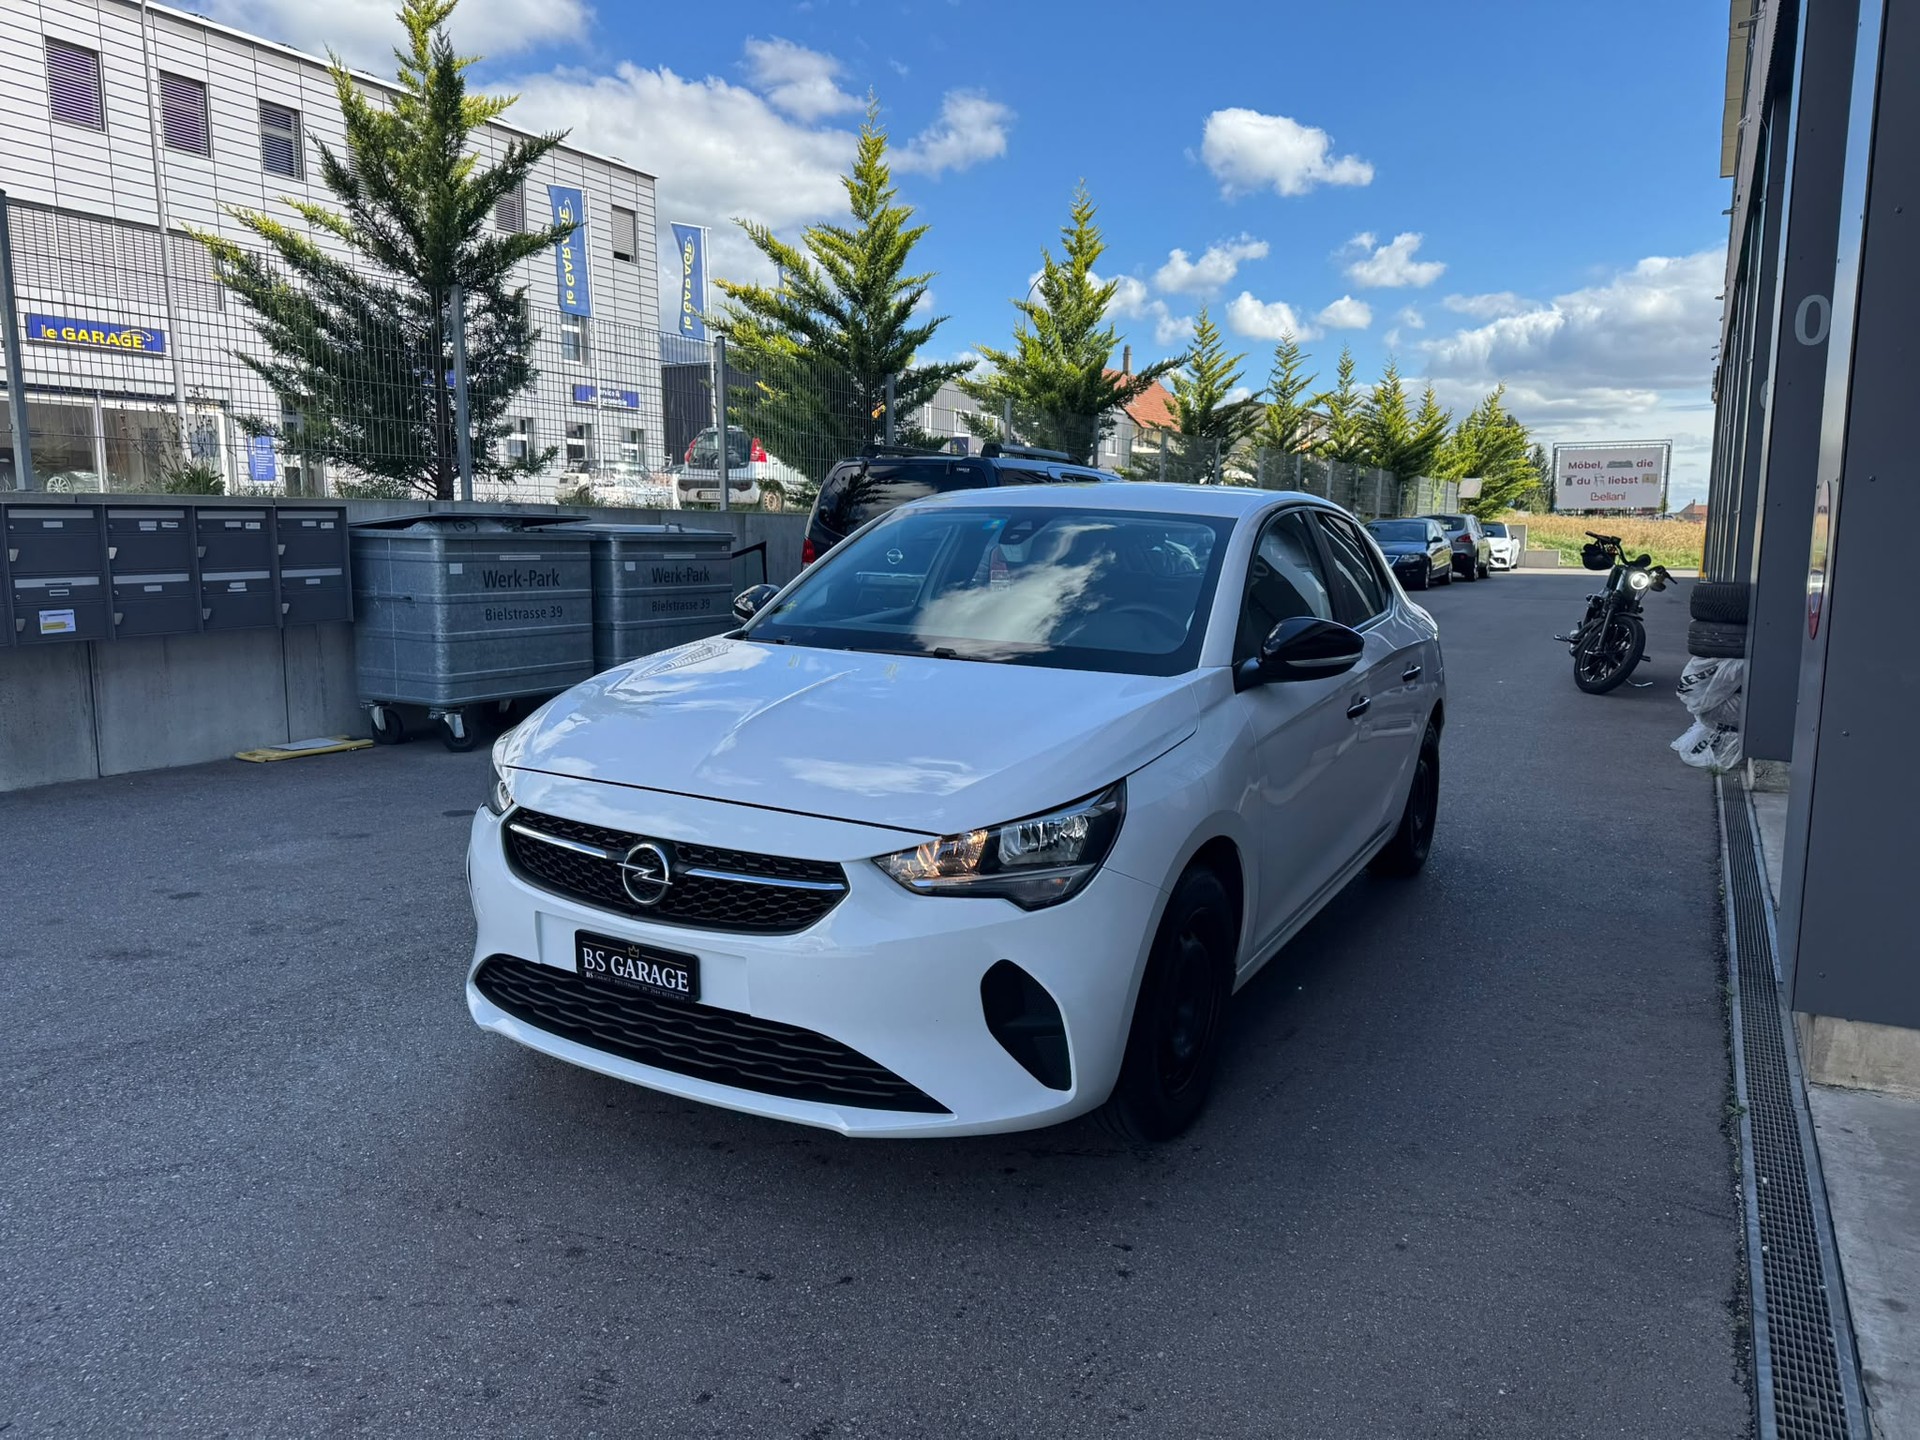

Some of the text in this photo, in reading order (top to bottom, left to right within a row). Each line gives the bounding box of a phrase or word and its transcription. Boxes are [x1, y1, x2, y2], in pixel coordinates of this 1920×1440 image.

[41, 324, 146, 349] le GARAGE
[1568, 459, 1654, 470] Möbel, die
[1576, 476, 1639, 486] du liebst
[1590, 492, 1627, 502] Beliani
[482, 568, 561, 589] Werk-Park
[651, 565, 711, 585] Werk-Park
[484, 605, 564, 622] Bielstrasse 39
[651, 598, 711, 613] Bielstrasse 39
[582, 947, 690, 993] BS GARAGE
